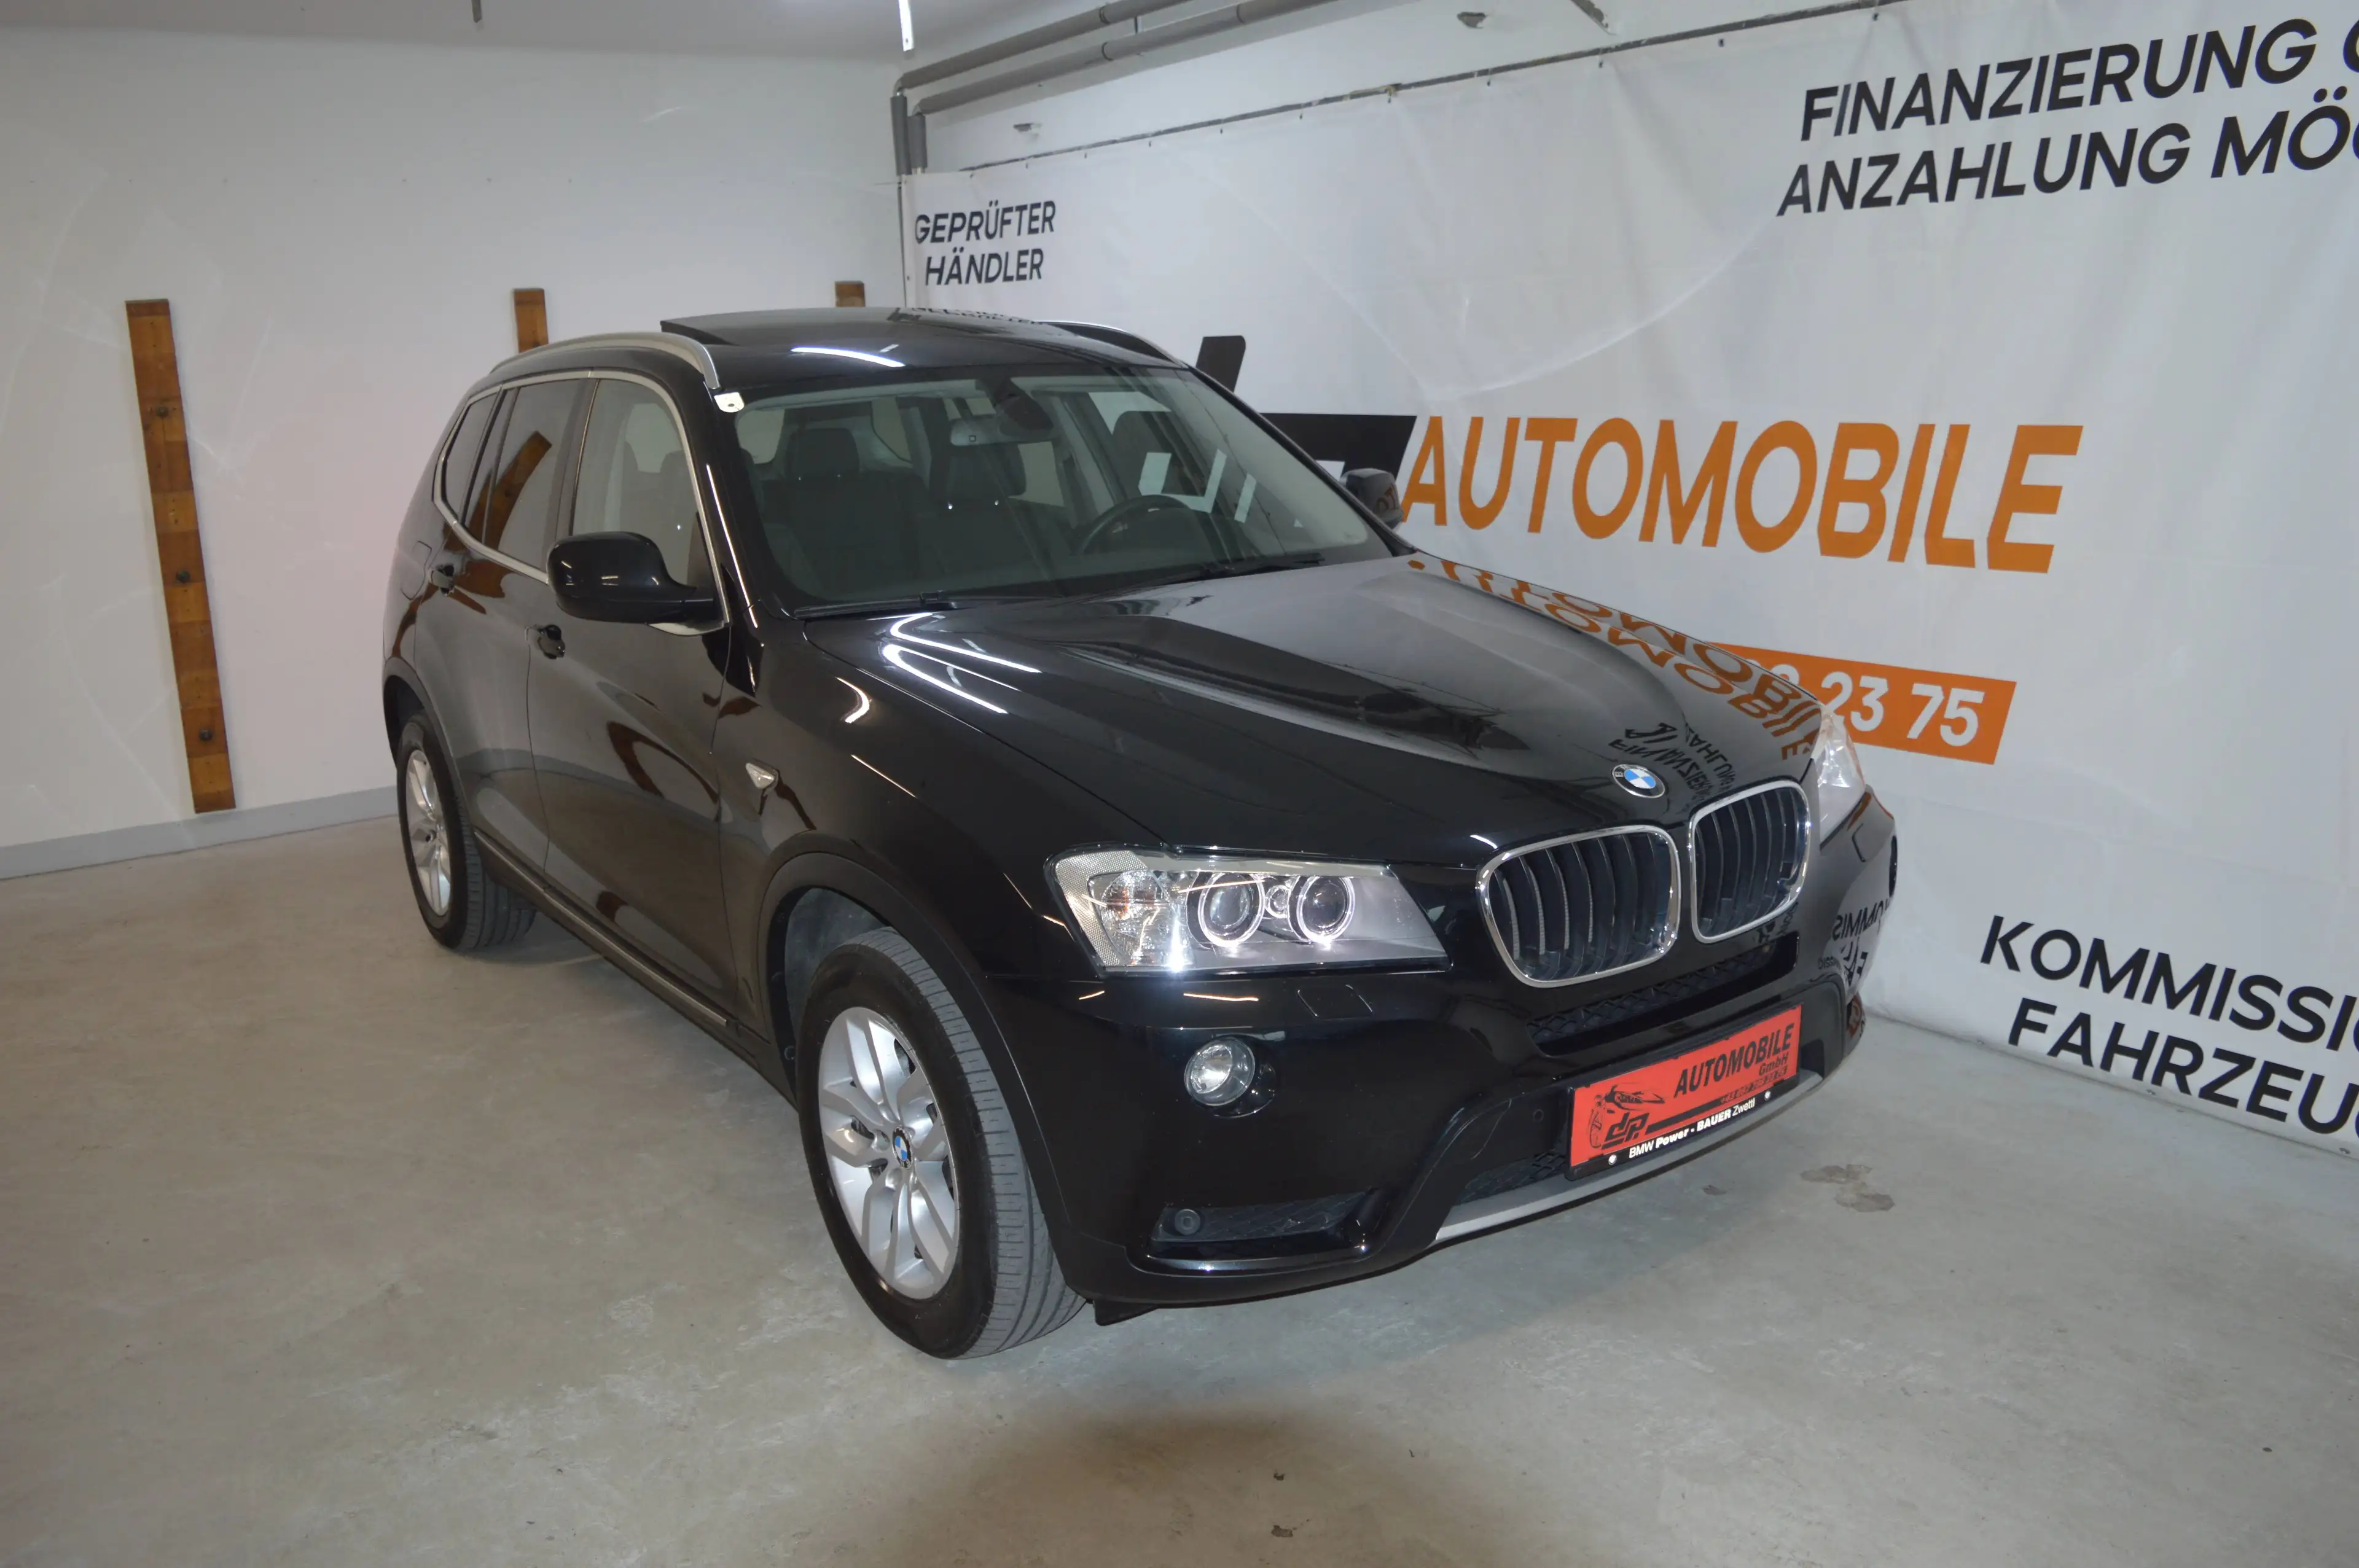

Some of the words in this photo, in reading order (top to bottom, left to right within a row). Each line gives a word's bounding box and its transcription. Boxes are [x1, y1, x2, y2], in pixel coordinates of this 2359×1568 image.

[1801, 18, 2317, 142] FINANZIERUNG
[1775, 122, 2191, 217] ANZAHLUNG
[2210, 85, 2359, 179] MÖ
[914, 199, 1056, 244] GEPRÜFTER
[925, 246, 1044, 286] HÄNDLER
[1401, 415, 2084, 574] AUTOMOBILE
[1820, 671, 1889, 732] 23
[1906, 682, 1985, 747] 75
[1980, 915, 2359, 1051] KOMMISSI
[1673, 1023, 1795, 1098] AUTOMOBILE
[1759, 1051, 1789, 1075] GmbH
[2008, 997, 2359, 1138] FAHRZEU
[1629, 1140, 1655, 1159] BMW
[1655, 1128, 1689, 1149] Power
[1697, 1109, 1732, 1133] BAUER
[1732, 1097, 1756, 1117] Zwettl
